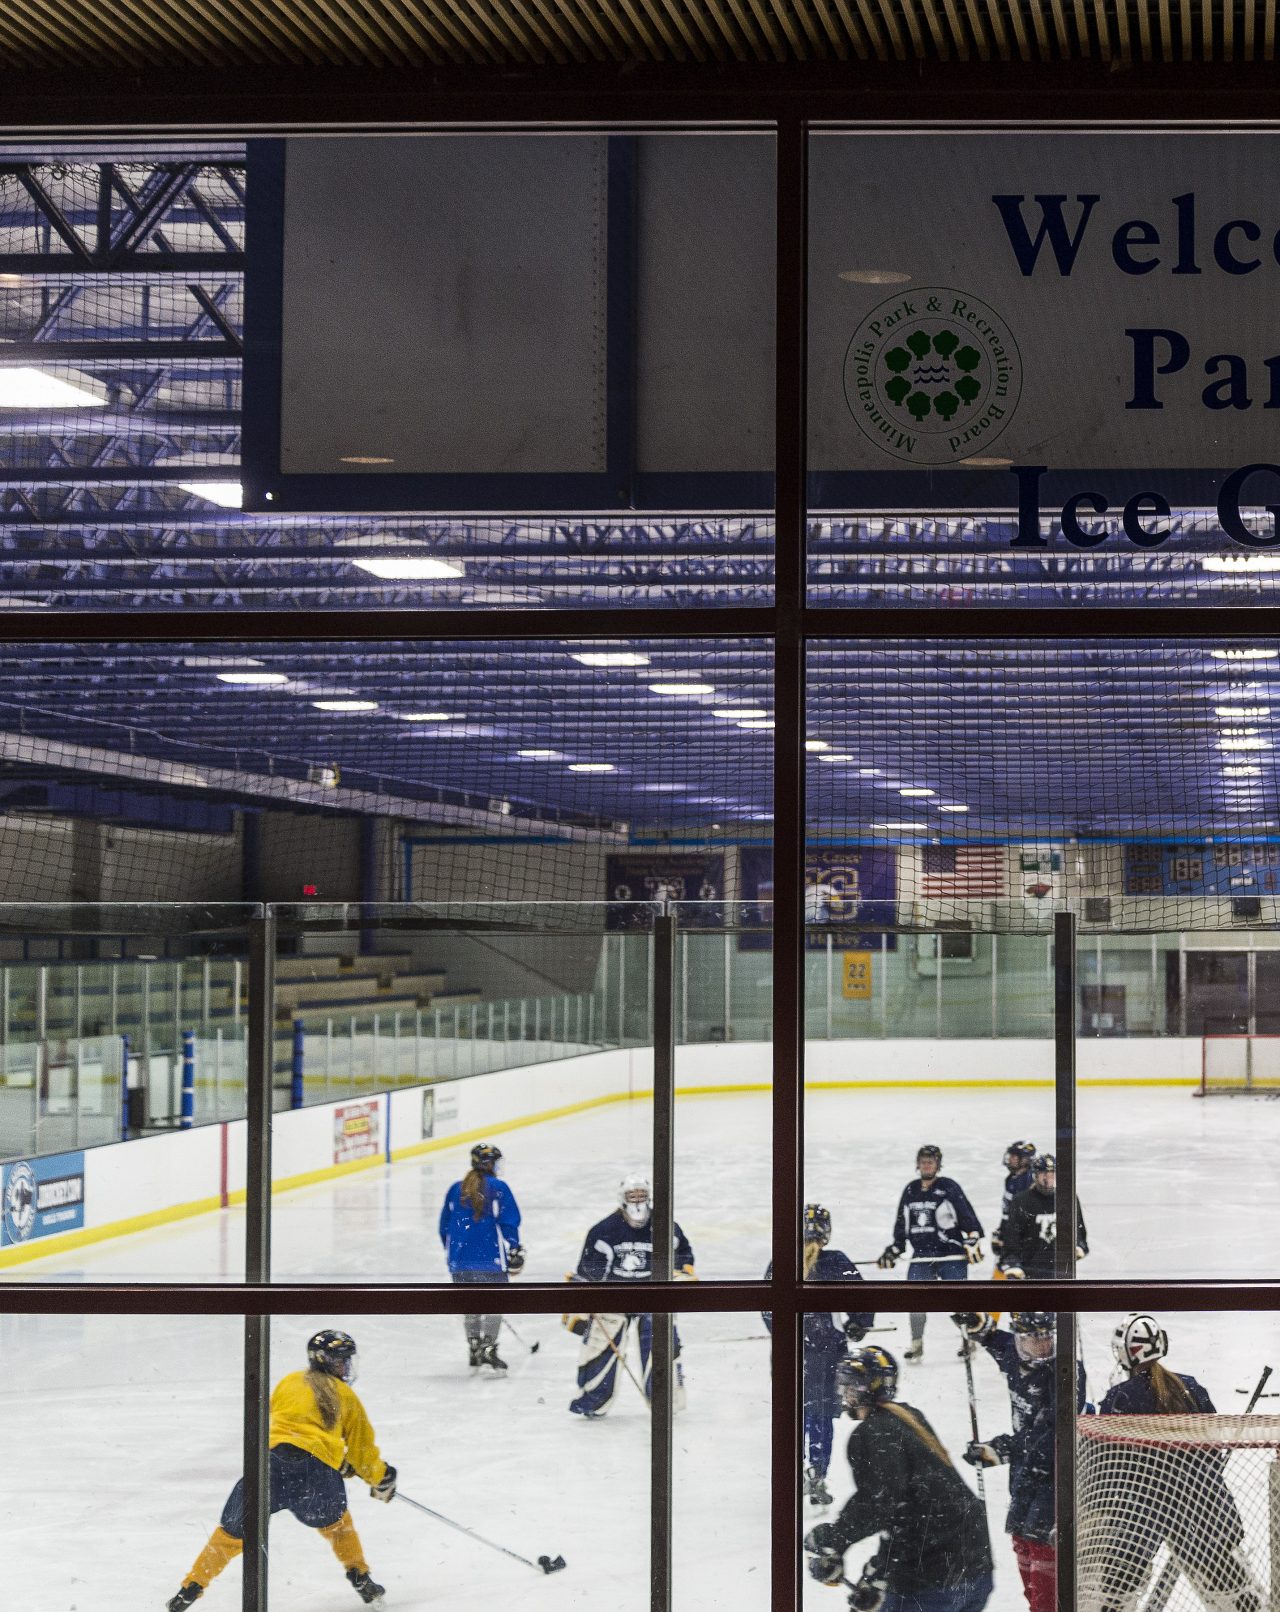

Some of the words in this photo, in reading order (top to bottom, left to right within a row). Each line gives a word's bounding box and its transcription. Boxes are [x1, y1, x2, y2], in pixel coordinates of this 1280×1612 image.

[868, 300, 917, 338] Park
[926, 296, 942, 312] &
[951, 298, 1014, 397] Recreation
[853, 340, 917, 453] Minneapolis
[948, 402, 1006, 453] Board
[1010, 466, 1171, 548] Ice
[848, 963, 866, 979] 22
